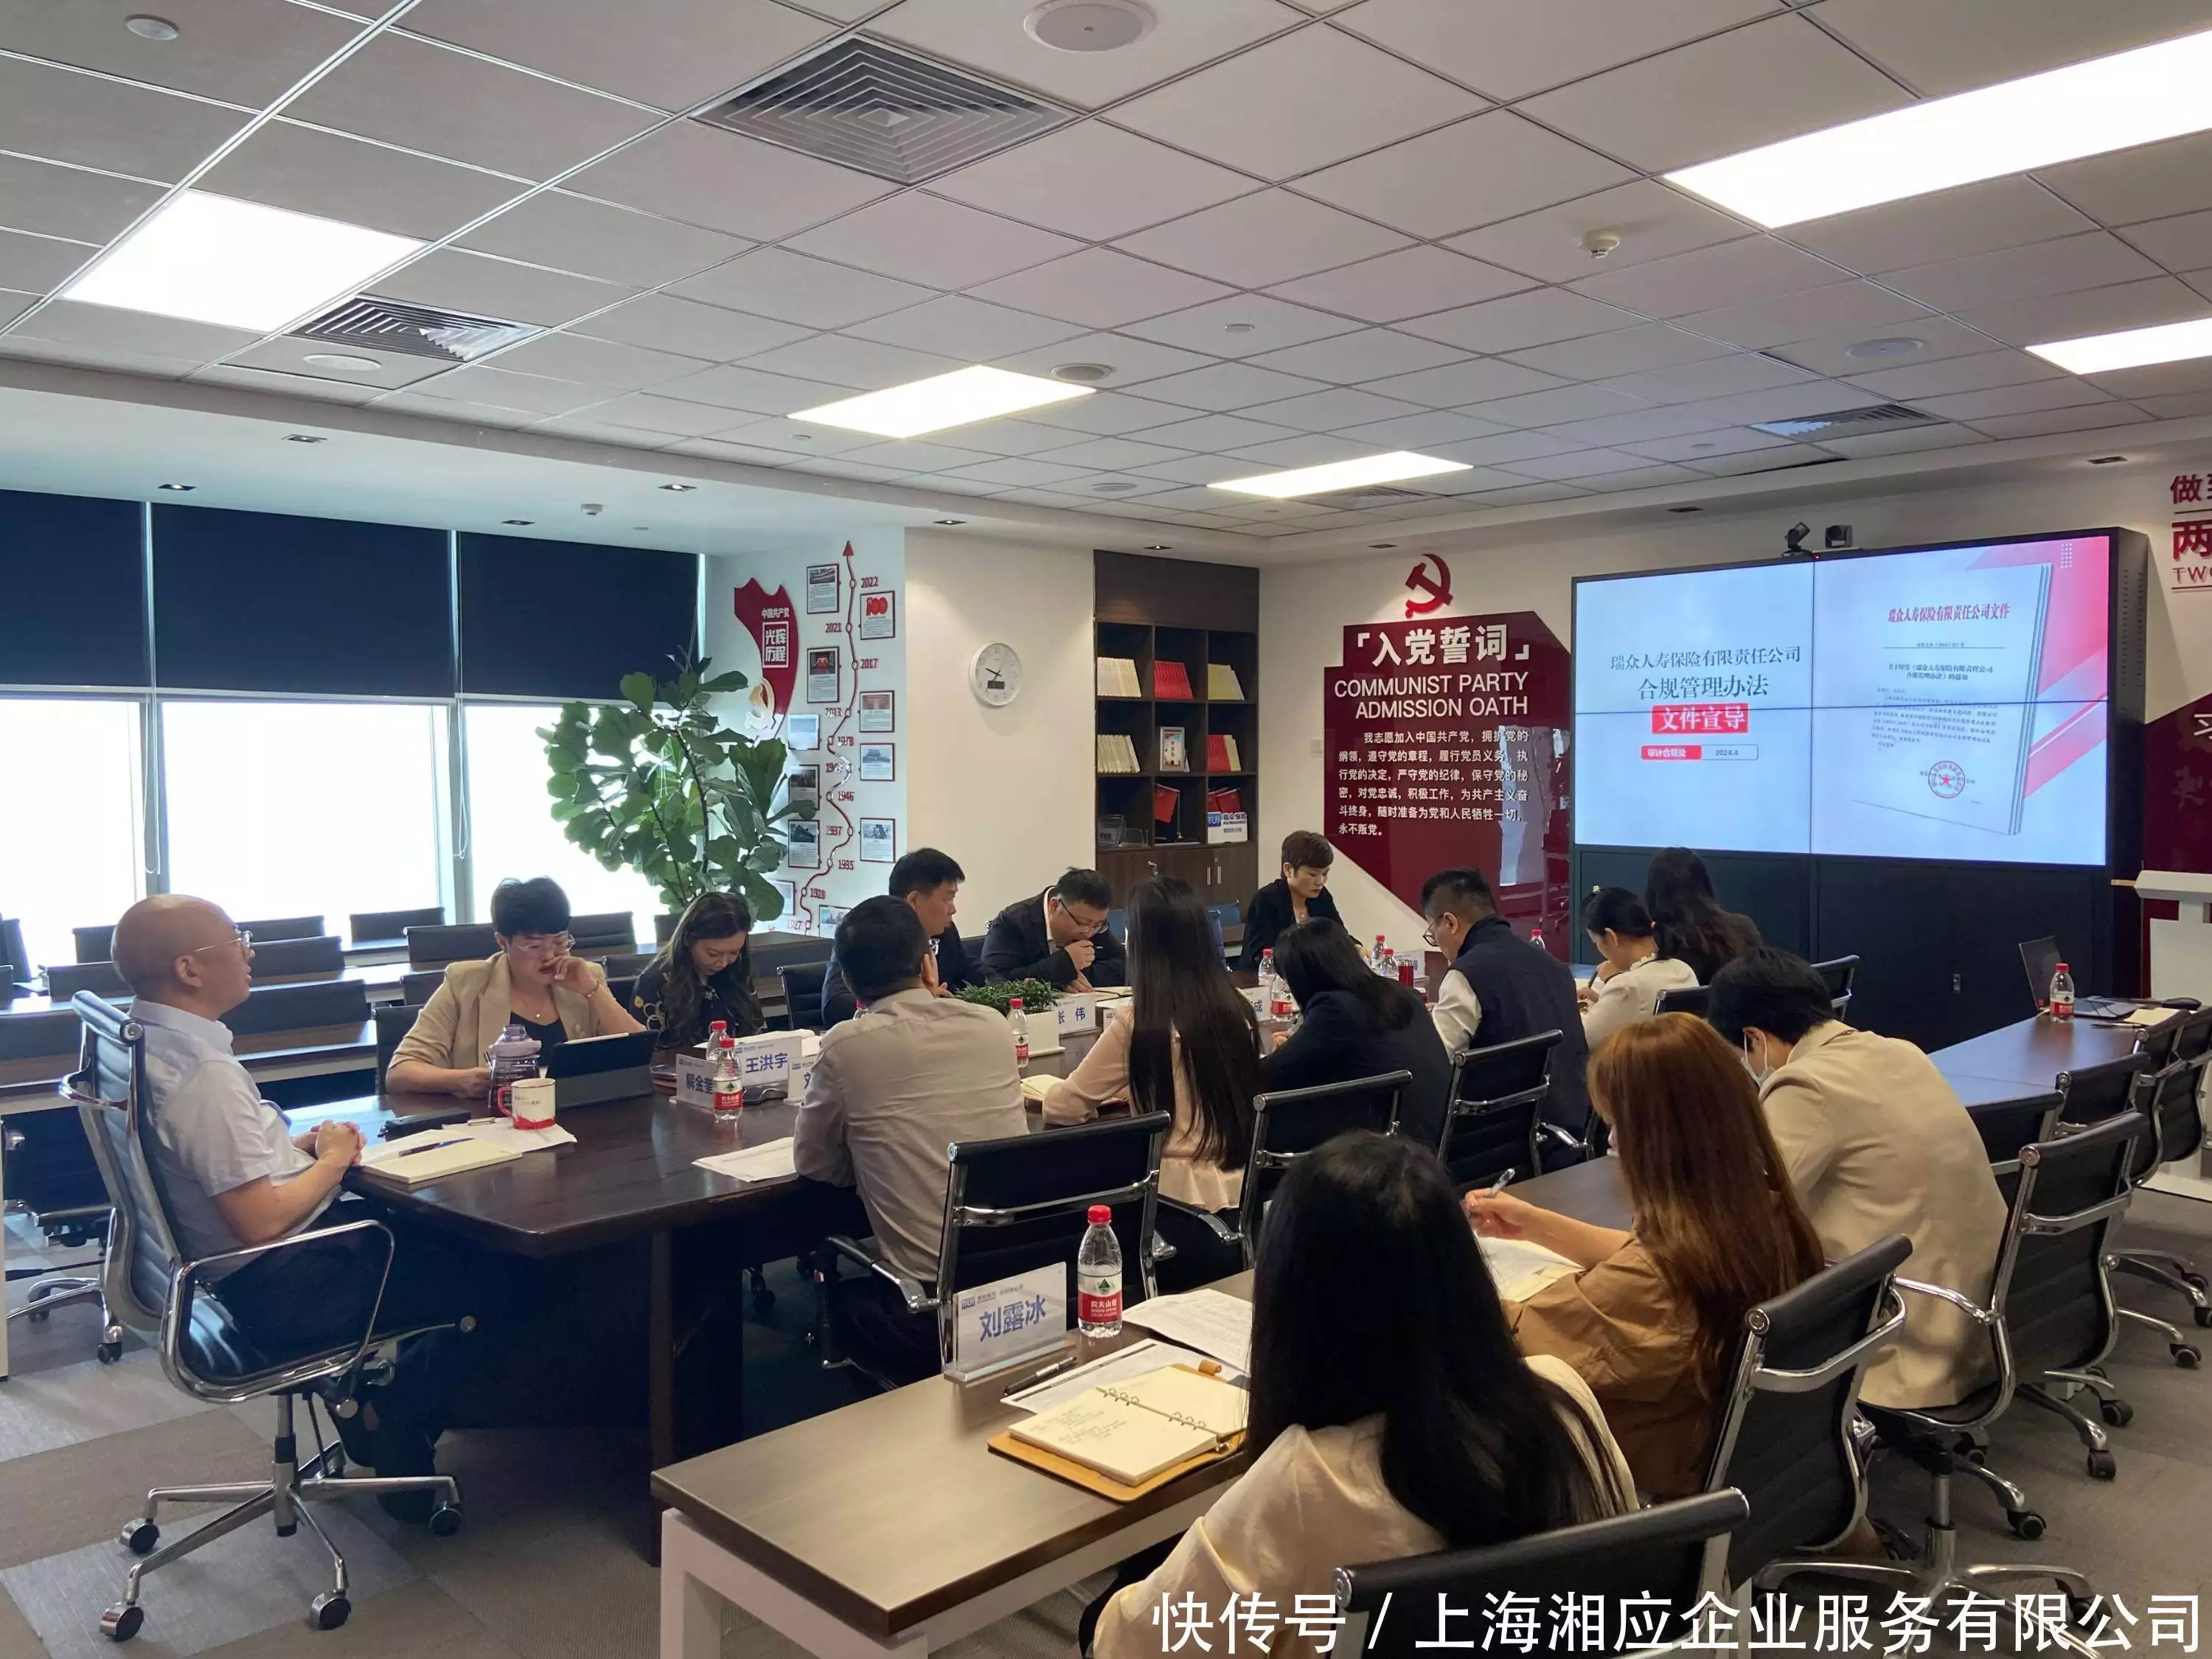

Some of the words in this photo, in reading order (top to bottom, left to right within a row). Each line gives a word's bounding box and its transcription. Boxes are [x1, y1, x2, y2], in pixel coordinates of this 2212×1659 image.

[861, 577, 878, 588] 2022
[2172, 566, 2212, 583] TW
[762, 608, 790, 619] 中国共产党
[1888, 602, 2010, 623] 瑞众人寿保险有限责任公司文件
[765, 629, 786, 644] 光辉
[825, 622, 842, 633] 2021
[765, 646, 786, 662] 历程
[860, 658, 878, 669] 2017
[1610, 646, 1801, 670] 瑞众人寿保险有限责任公司
[1335, 675, 1453, 698] COMMUNIST
[1459, 672, 1529, 693] PARTY
[1638, 675, 1770, 700] 合规管理办法
[1355, 698, 1461, 719] ADMISSION
[1470, 696, 1528, 716] OATH
[1659, 706, 1746, 731] 文件宣导
[745, 1053, 788, 1074] 王洪宇
[979, 1295, 1046, 1342] 刘露冰
